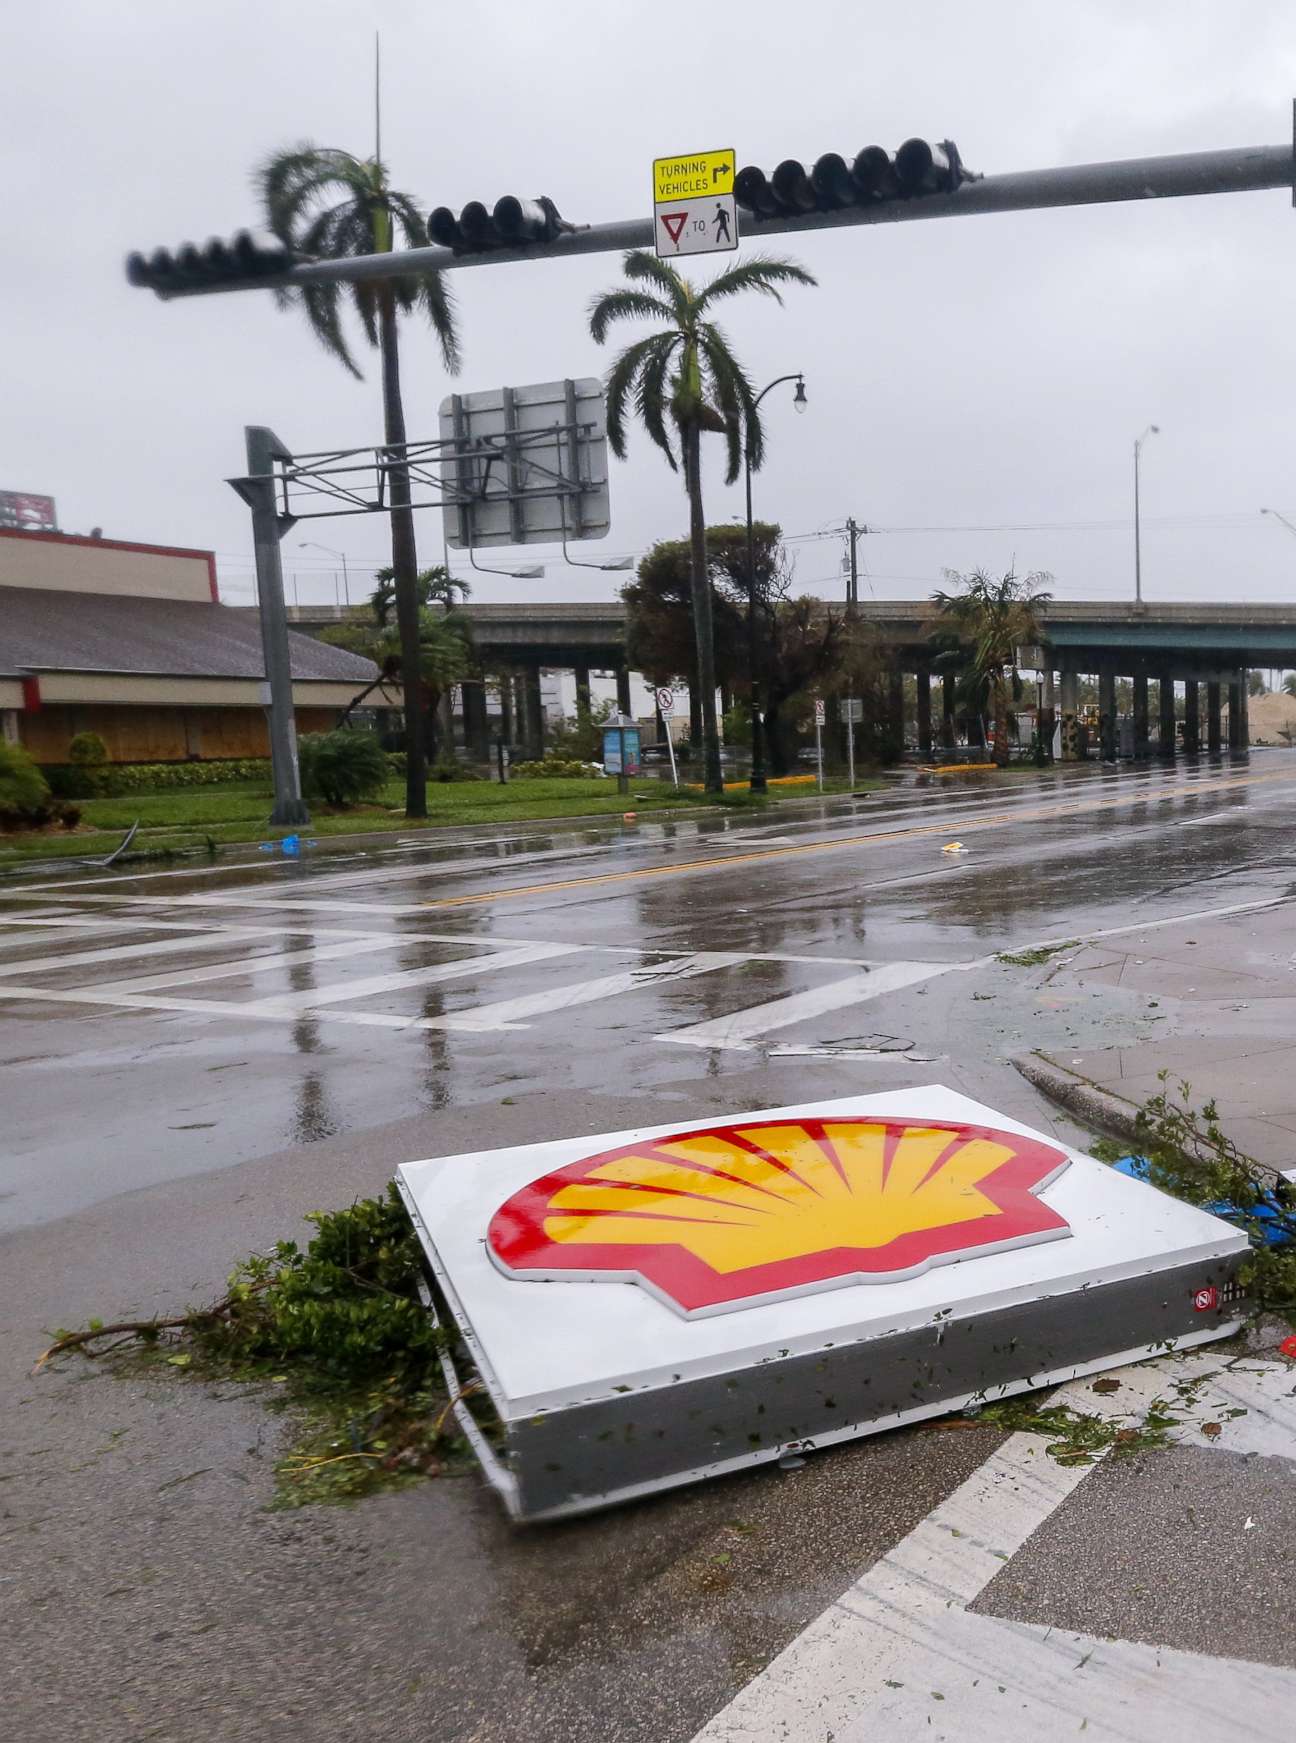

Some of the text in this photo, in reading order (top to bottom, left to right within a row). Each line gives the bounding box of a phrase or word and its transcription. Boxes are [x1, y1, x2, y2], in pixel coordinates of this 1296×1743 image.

[660, 161, 706, 178] TURNING
[659, 179, 708, 195] VEHICLES
[692, 220, 705, 232] TO
